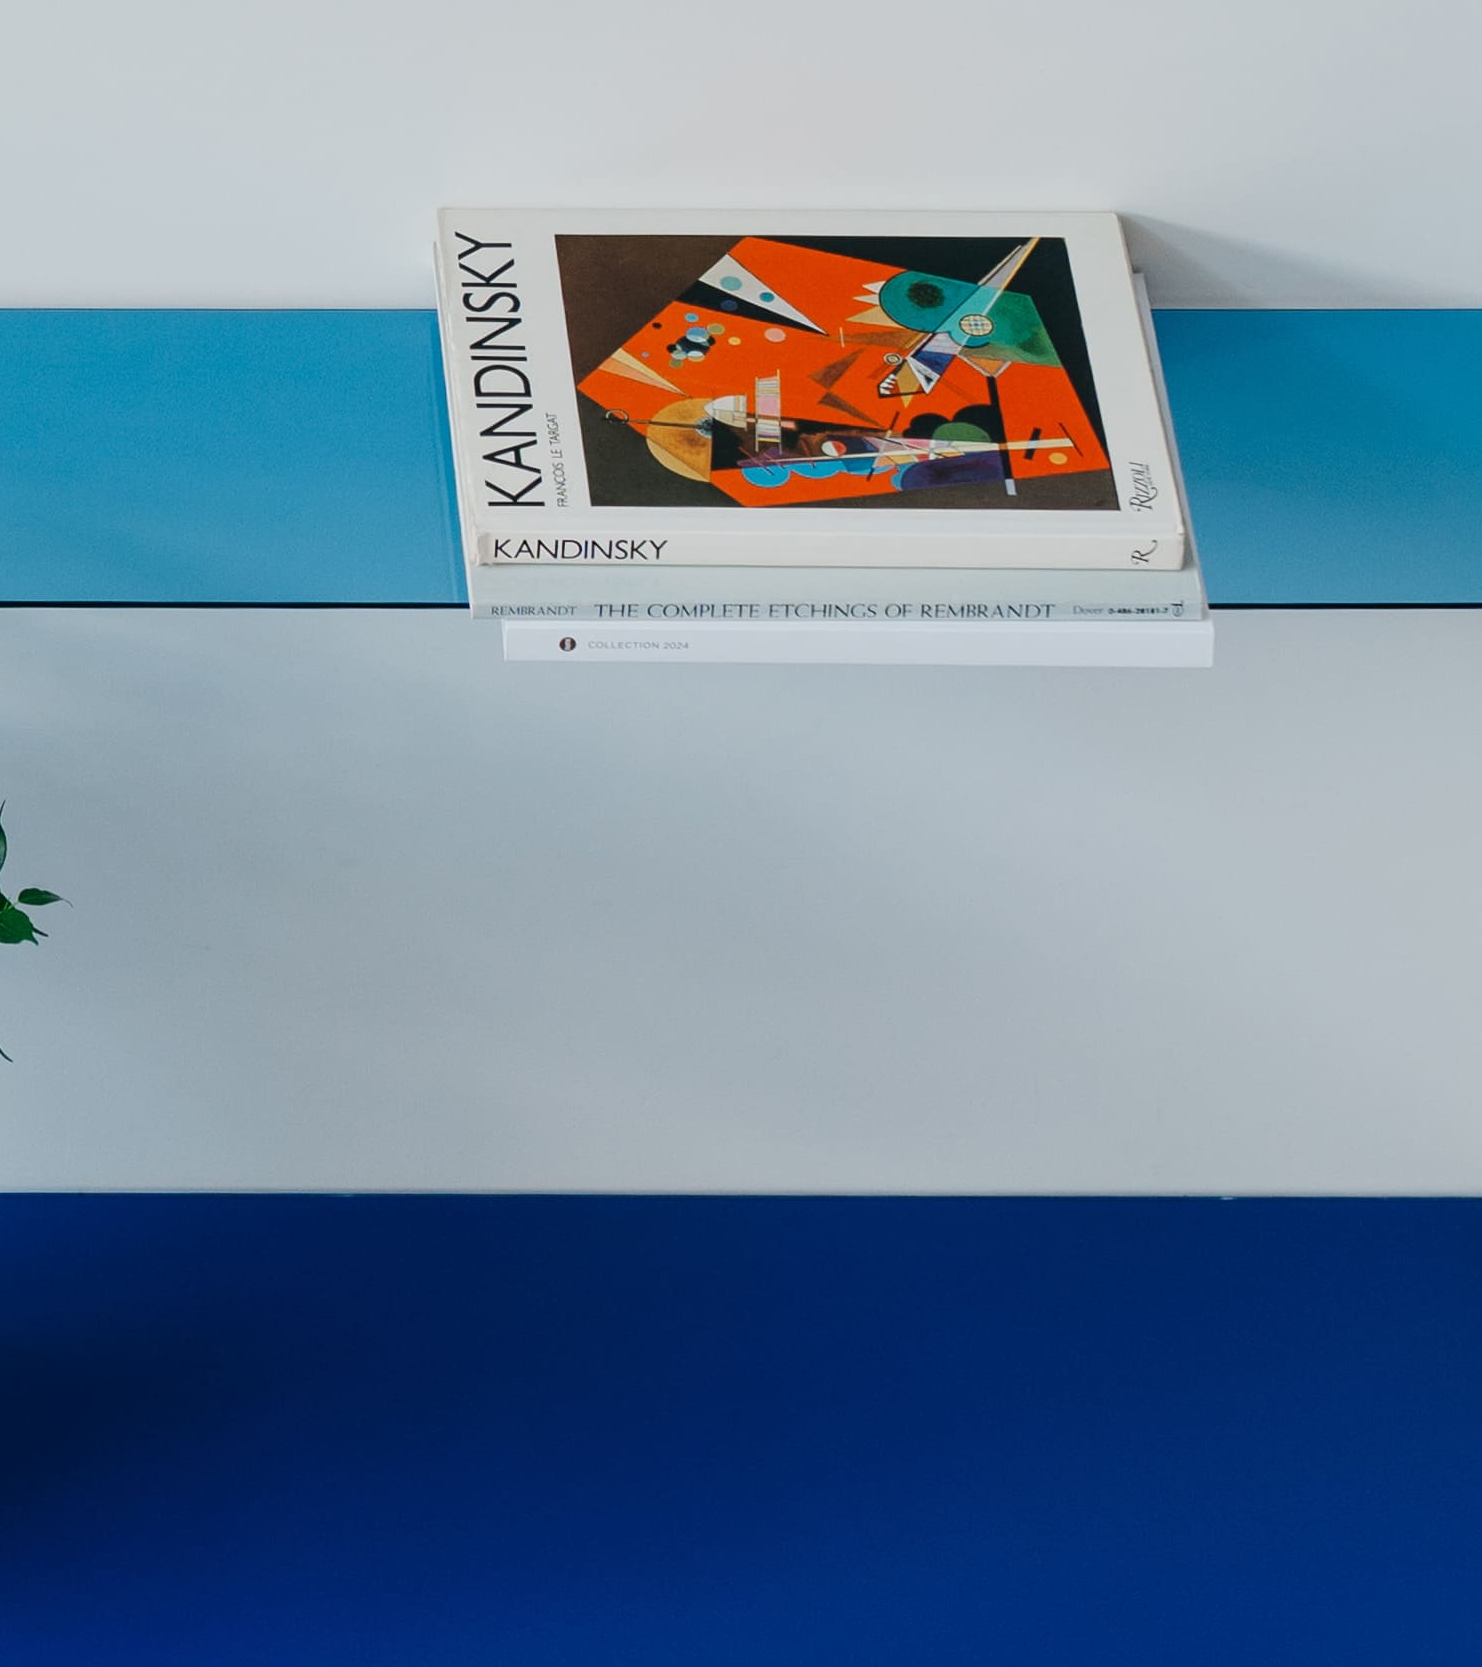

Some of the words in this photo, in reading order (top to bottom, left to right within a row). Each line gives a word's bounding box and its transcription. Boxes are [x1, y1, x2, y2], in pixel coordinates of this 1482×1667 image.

[455, 231, 545, 506] KANDINSKY
[552, 449, 563, 458] LE
[494, 539, 668, 559] KANDINSKY
[491, 606, 577, 616] REMBRANDT
[594, 603, 639, 618] THE
[647, 604, 760, 618] COMPLETE
[769, 604, 877, 619] ETCHINGS
[885, 604, 912, 618] OF
[921, 604, 1055, 619] REMBRANDT
[1073, 606, 1103, 615] Dover
[588, 641, 659, 650] COLLECTION
[664, 642, 689, 650] 2024
